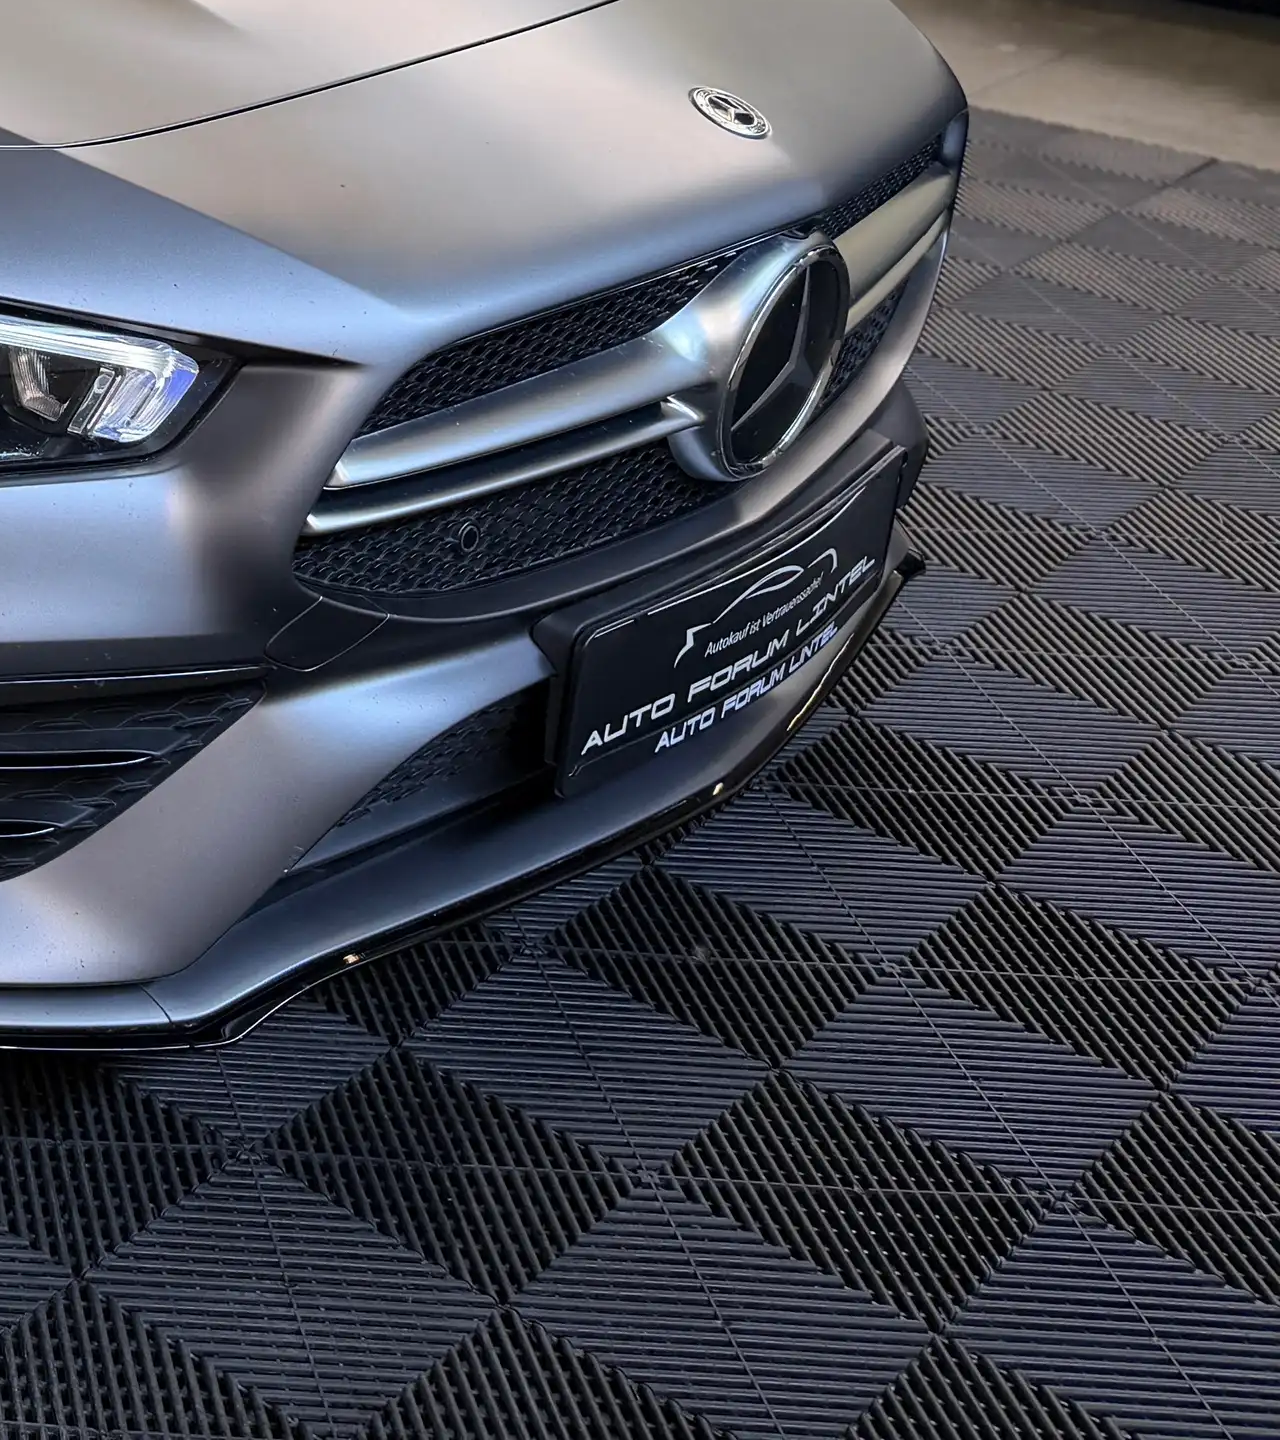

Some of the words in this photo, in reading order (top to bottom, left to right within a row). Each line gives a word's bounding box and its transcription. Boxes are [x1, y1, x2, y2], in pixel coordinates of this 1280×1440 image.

[580, 693, 676, 756] AUTO
[687, 628, 790, 703] FORUM
[795, 555, 876, 637] LINTEL
[654, 706, 716, 753] AUTO
[720, 662, 786, 719] FORUM
[788, 620, 839, 674] LINTEL
[704, 621, 751, 658] Autokauf
[749, 619, 761, 636] ist
